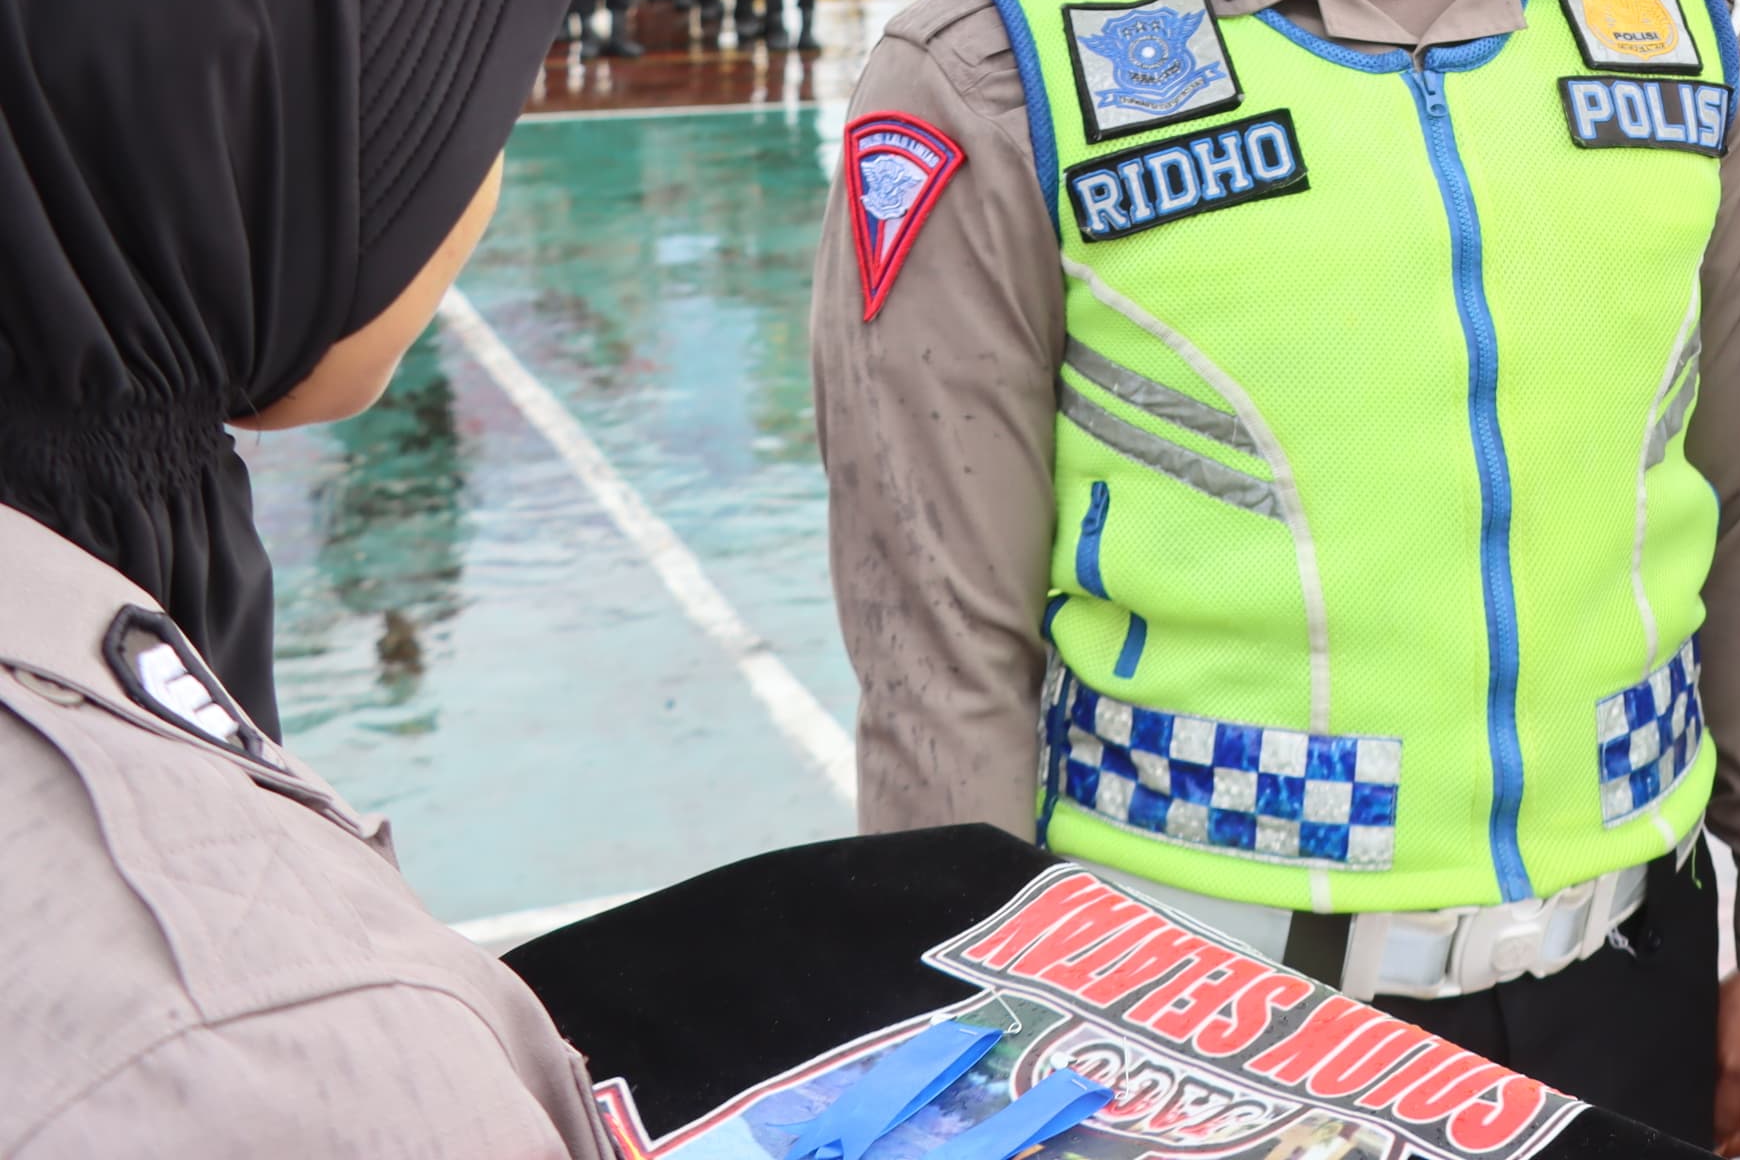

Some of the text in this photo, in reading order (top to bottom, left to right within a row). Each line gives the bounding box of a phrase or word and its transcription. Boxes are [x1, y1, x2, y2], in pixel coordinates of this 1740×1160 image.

[1612, 31, 1660, 41] POLISI
[1074, 121, 1295, 233] RIDHO
[961, 872, 1568, 1153] SOLOK SELATAN
